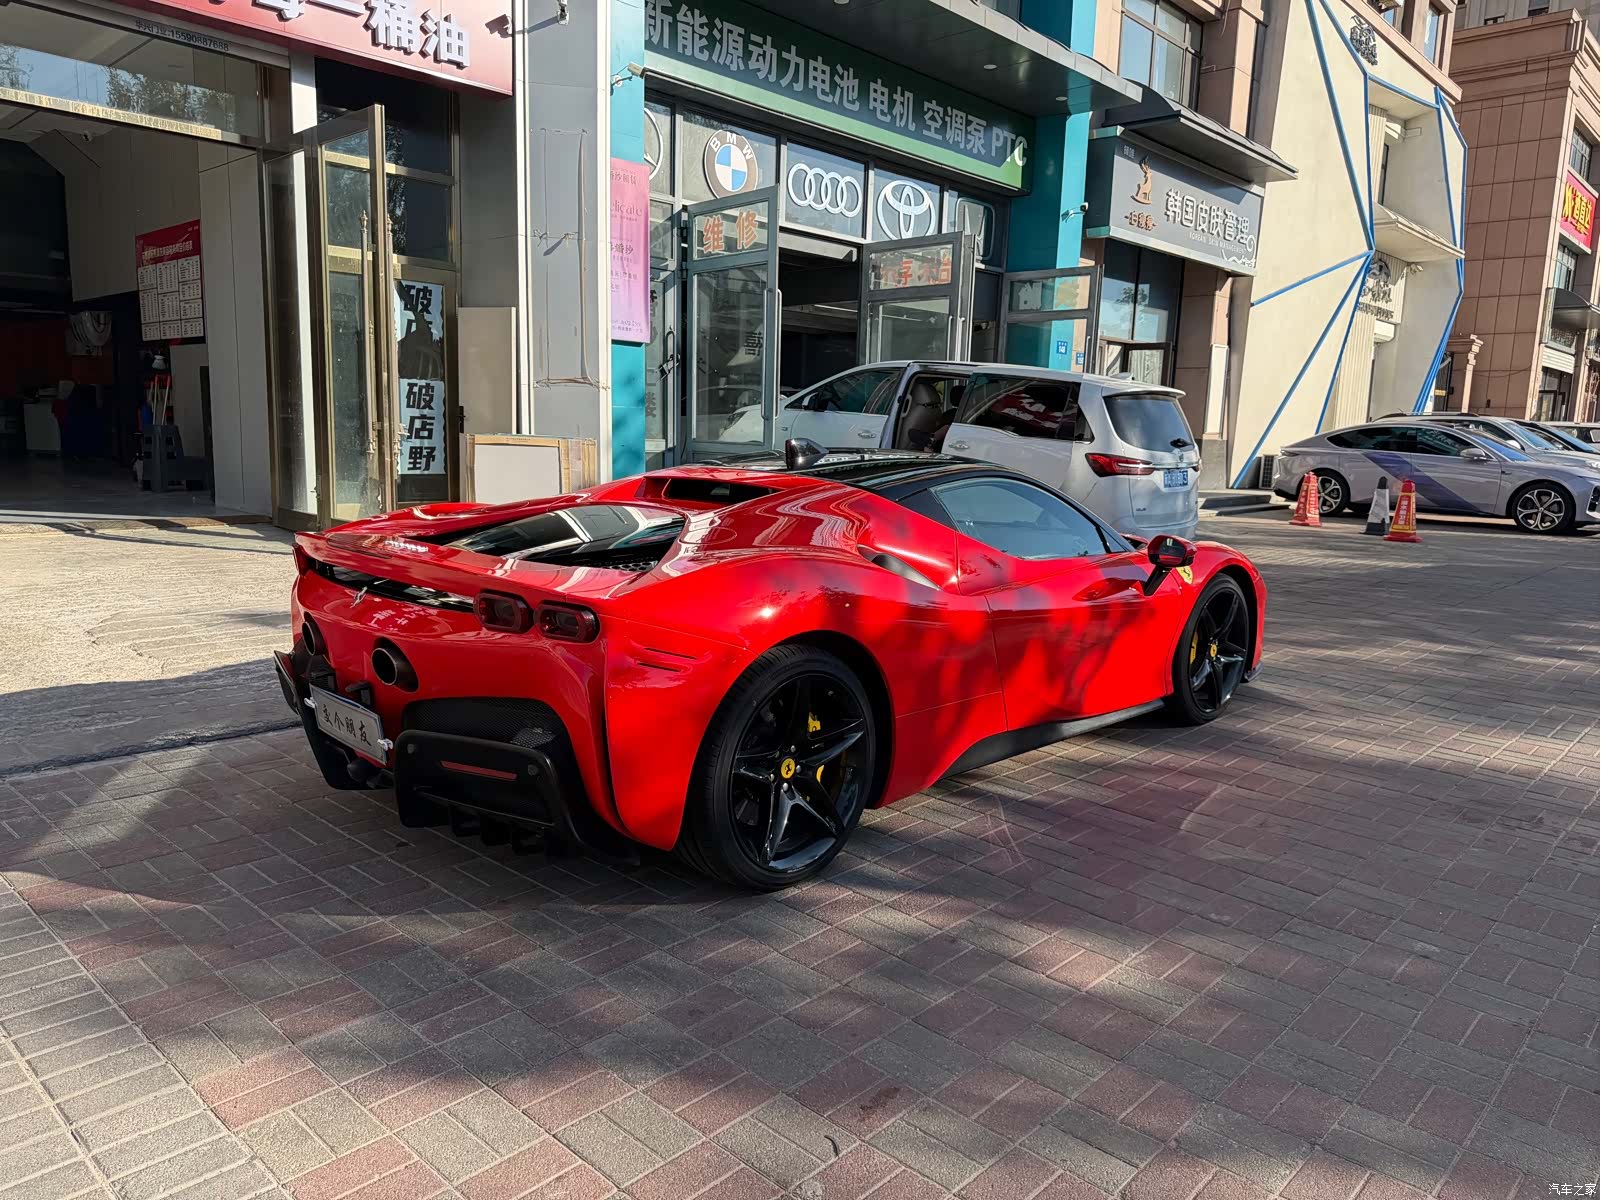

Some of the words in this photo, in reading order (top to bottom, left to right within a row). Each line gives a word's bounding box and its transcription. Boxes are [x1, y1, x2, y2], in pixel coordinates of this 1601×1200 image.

[645, 0, 861, 111] 新能源动力电池
[868, 78, 916, 132] 电机
[922, 99, 987, 156] 空调泵
[992, 125, 1028, 167] PTC
[709, 131, 755, 161] BMW
[703, 209, 759, 254] 维修
[1165, 187, 1249, 245] 韩国皮肤管理
[405, 382, 437, 472] 破店野
